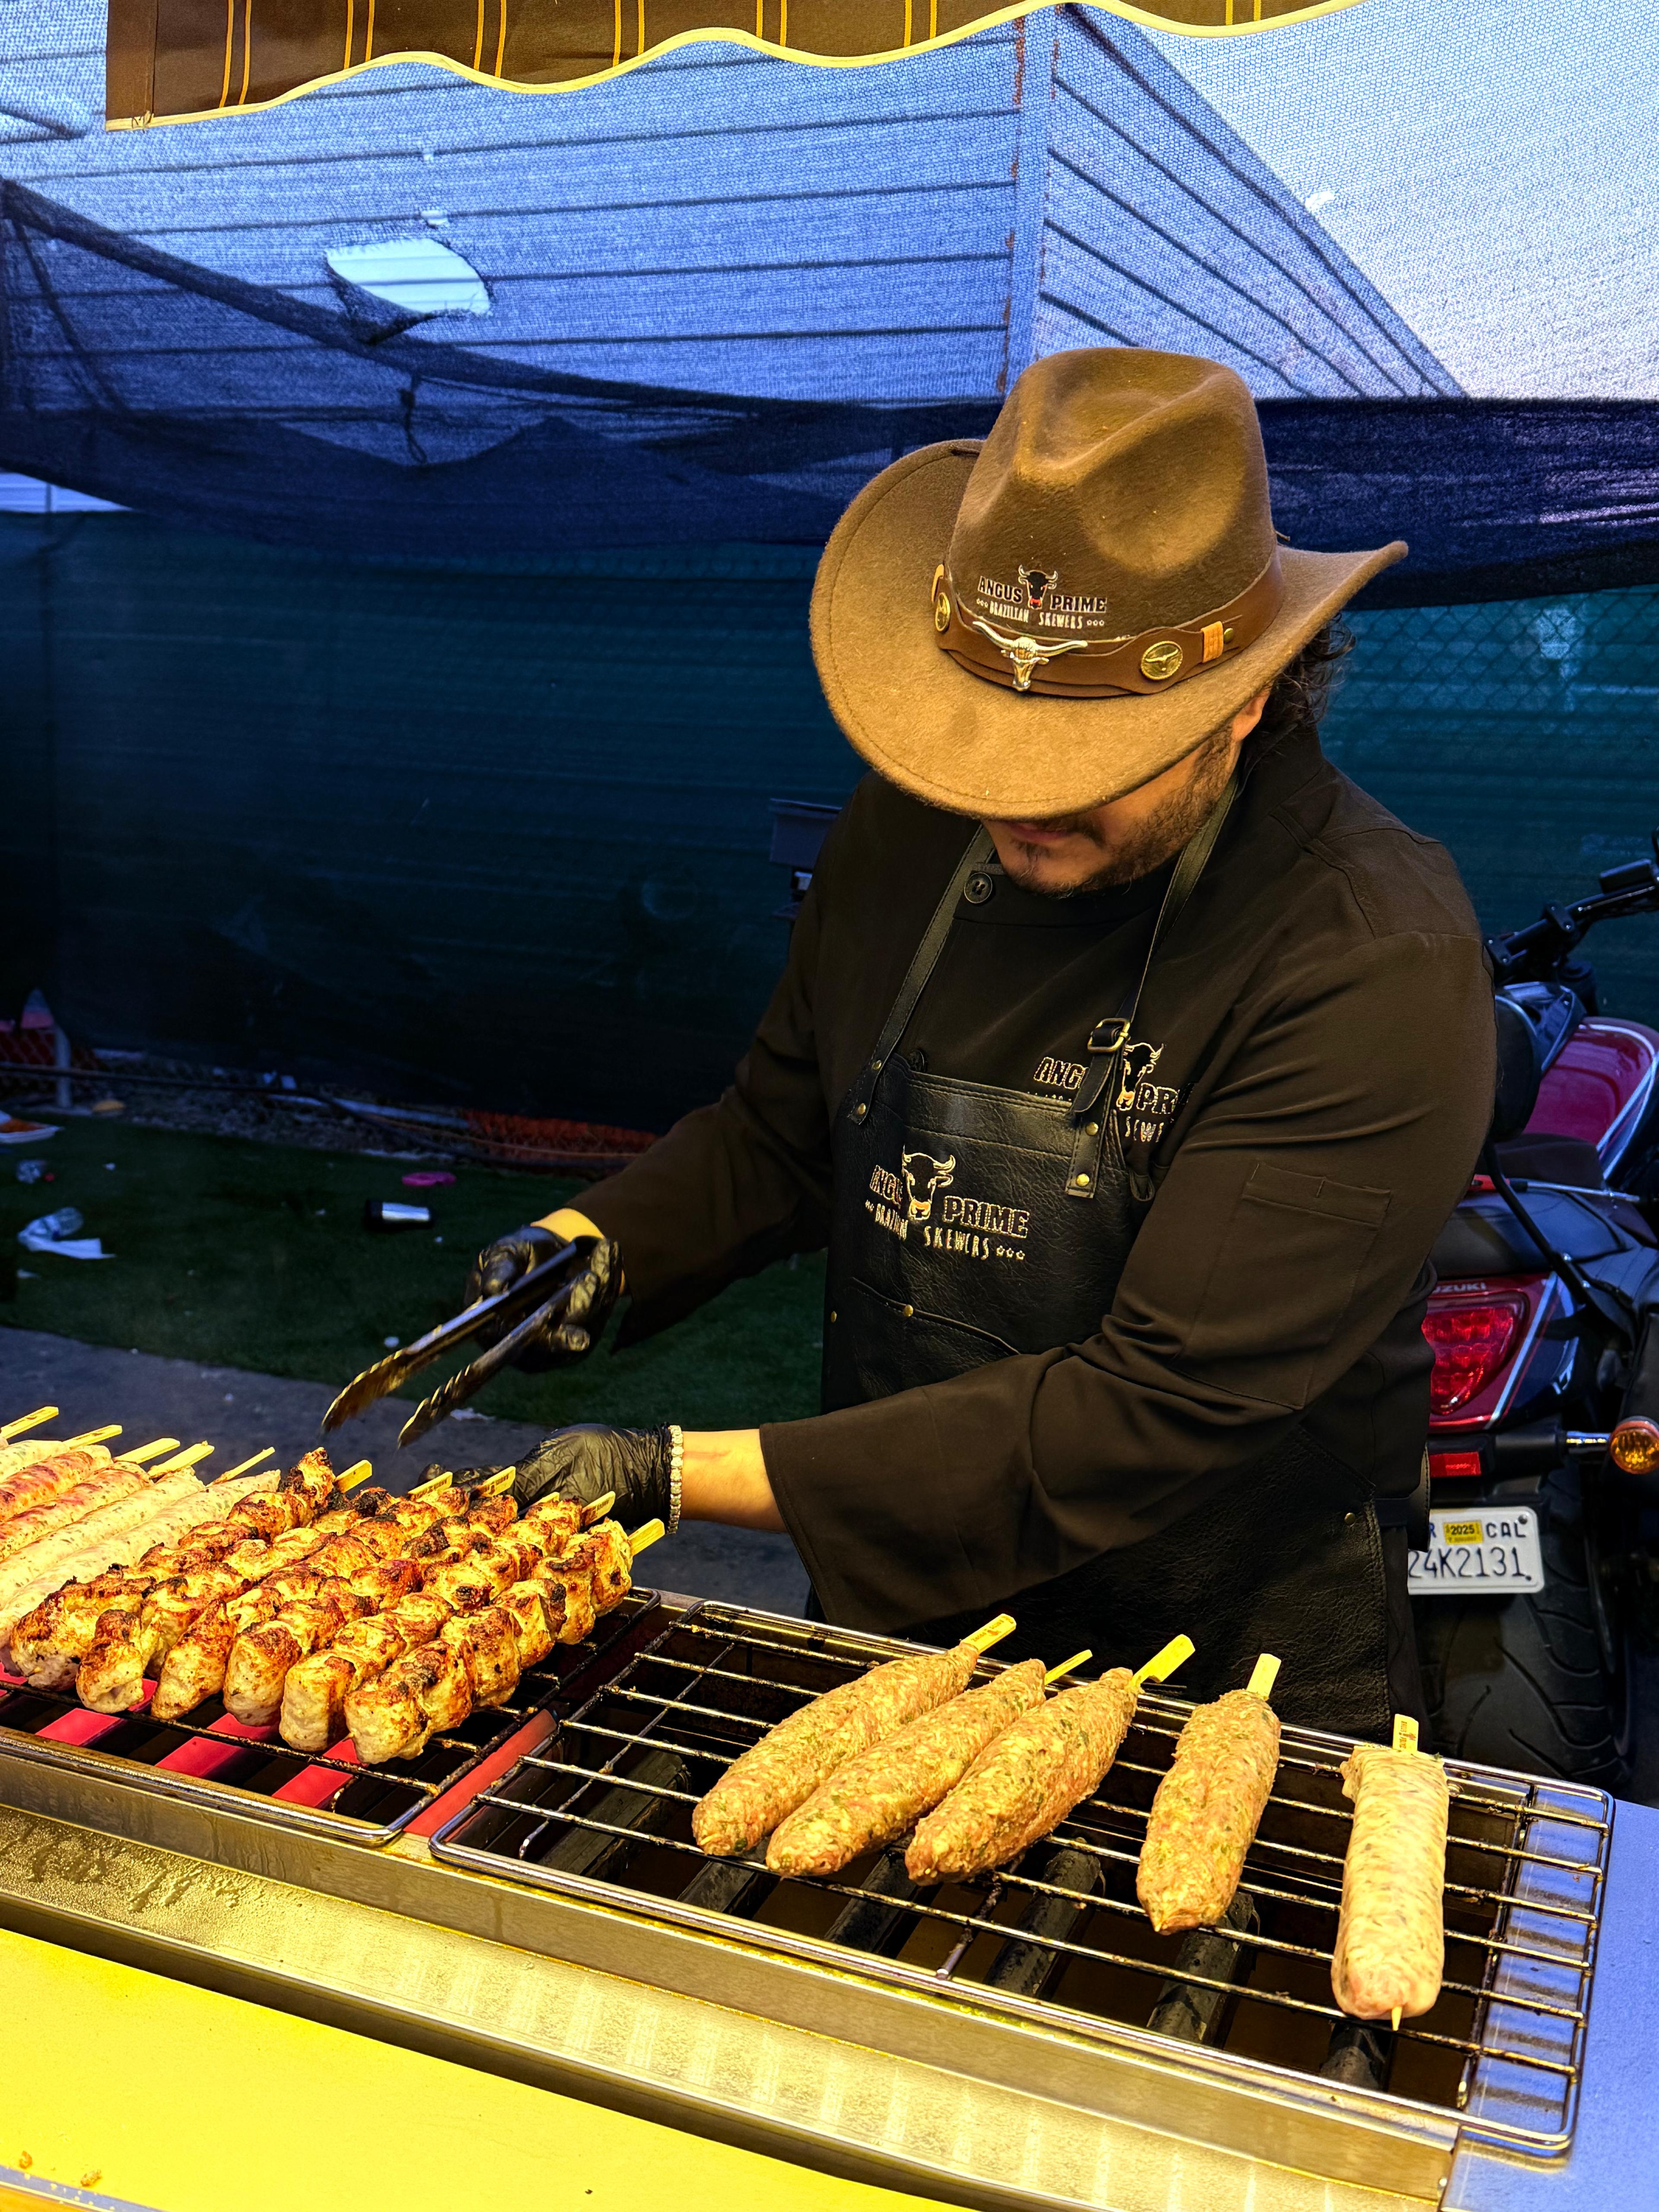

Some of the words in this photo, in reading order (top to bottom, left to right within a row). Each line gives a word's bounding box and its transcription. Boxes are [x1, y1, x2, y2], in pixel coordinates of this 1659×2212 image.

[978, 575, 1023, 604] ANGUS
[1050, 594, 1107, 613] PRIME
[989, 601, 1029, 623] BRAZILIAN
[1039, 612, 1083, 629] SKEWERS
[1033, 1057, 1089, 1090] ANG
[869, 1164, 903, 1209] ANGU
[942, 1195, 1030, 1239] PRIME
[924, 1226, 989, 1260] SKEWERS
[1432, 1282, 1487, 1293] UZUKI
[1450, 1524, 1475, 1535] 2025
[1486, 1522, 1526, 1538] CAL
[1408, 1547, 1526, 1578] 24K2131
